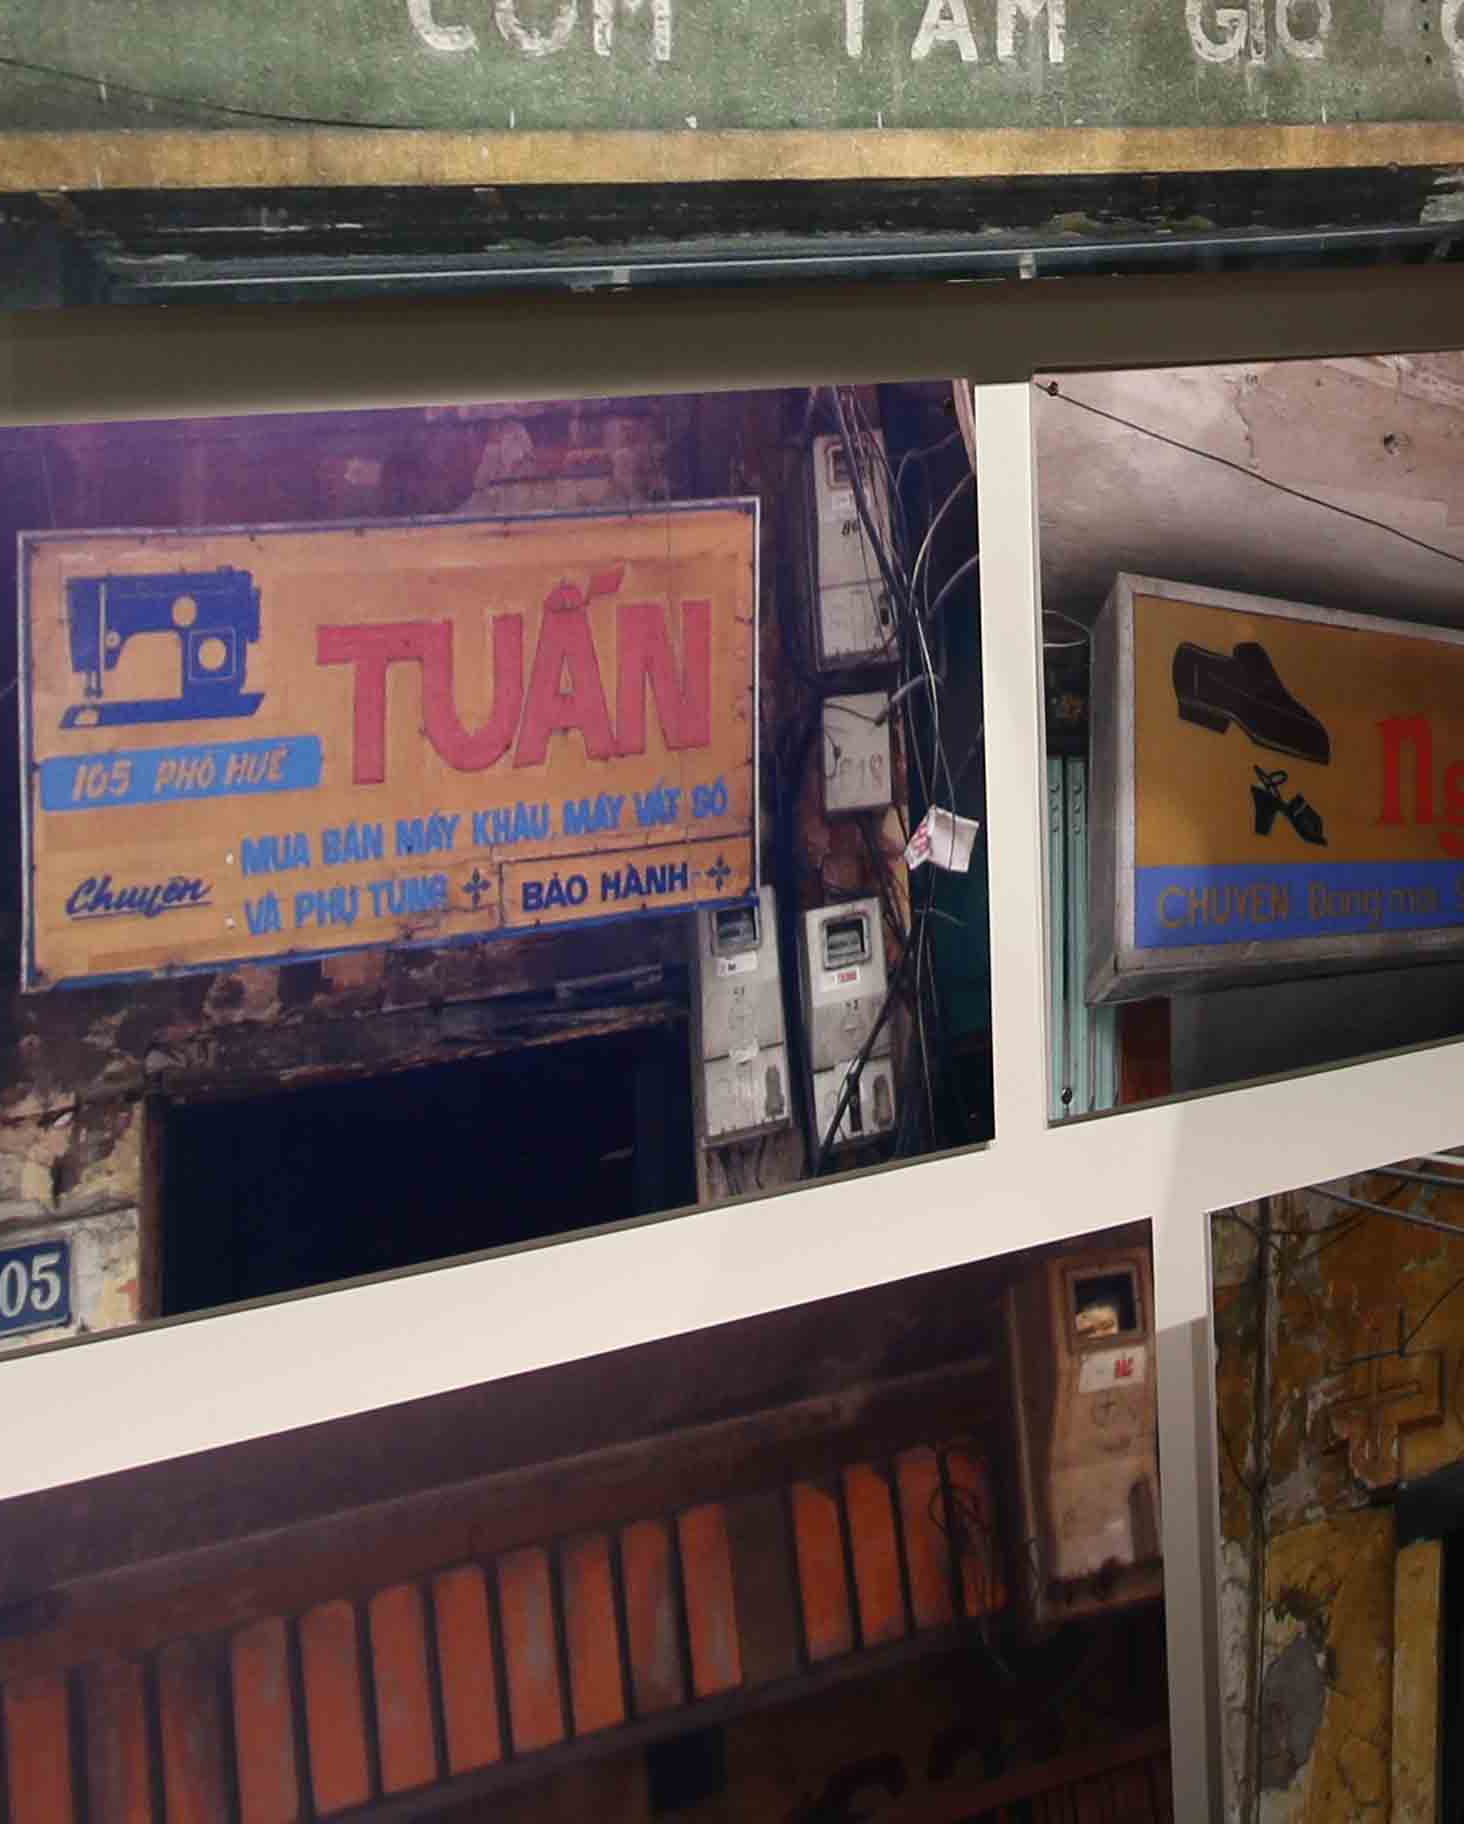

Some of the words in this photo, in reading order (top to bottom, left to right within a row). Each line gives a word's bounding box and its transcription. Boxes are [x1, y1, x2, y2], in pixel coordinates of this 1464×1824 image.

[316, 561, 713, 785] TUẤN
[71, 760, 134, 802] 105
[241, 831, 312, 875] MUA
[395, 808, 462, 857] MÁY
[63, 872, 214, 919] Chuyên
